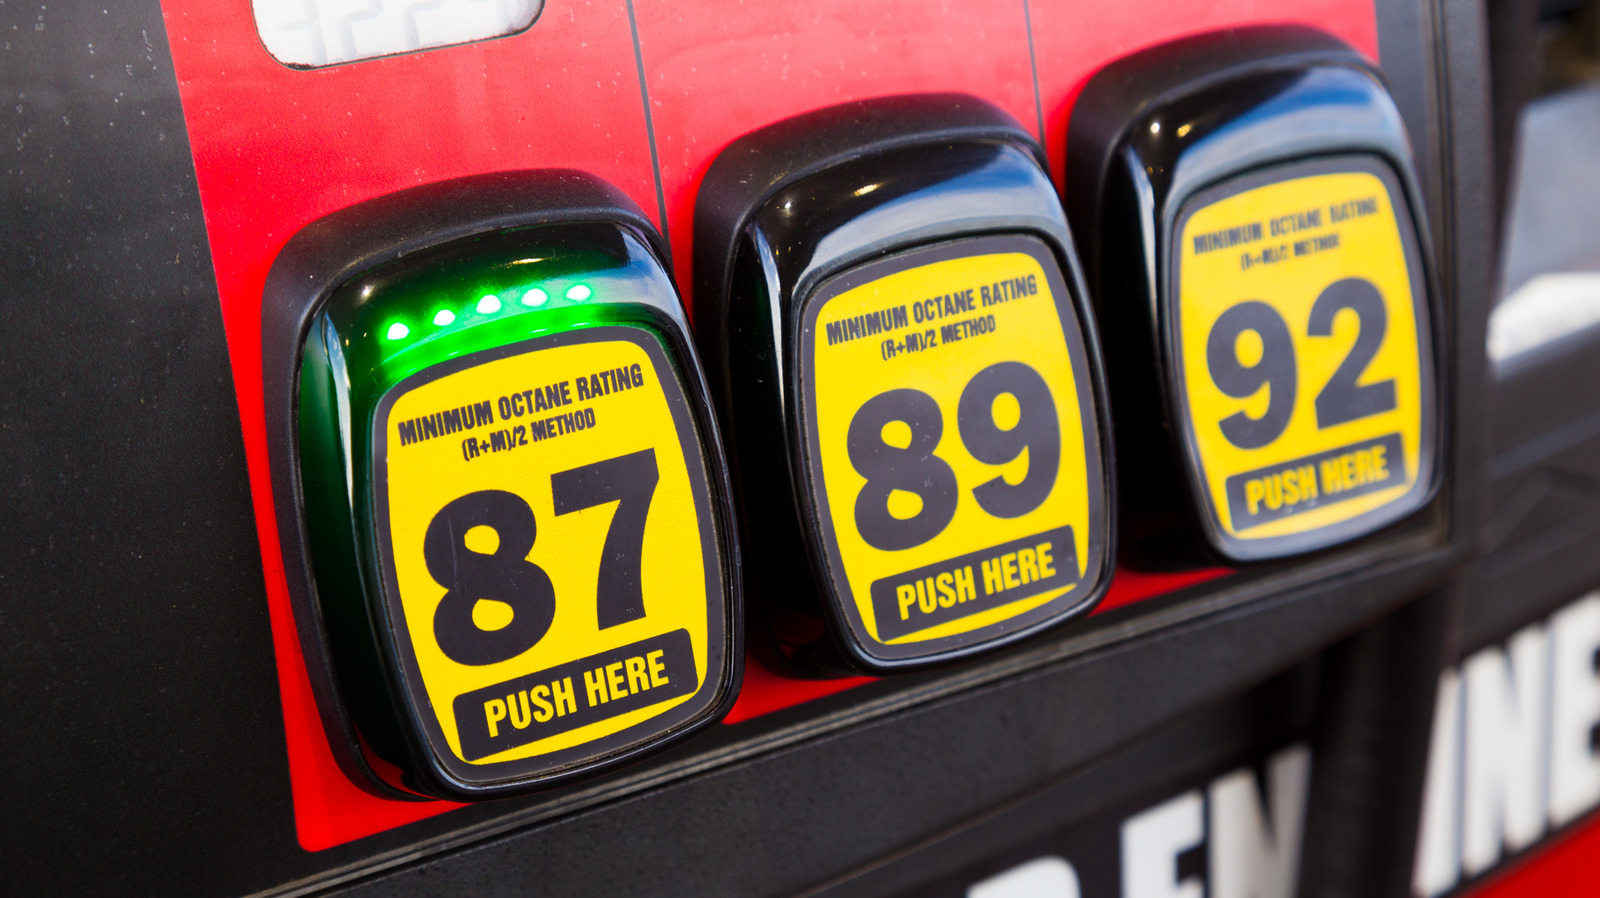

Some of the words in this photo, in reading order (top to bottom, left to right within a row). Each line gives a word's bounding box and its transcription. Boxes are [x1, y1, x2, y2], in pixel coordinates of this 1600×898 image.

[826, 304, 909, 346] MINIMUM
[912, 288, 976, 322] OCTANE
[980, 274, 1039, 308] RATING
[880, 326, 938, 361] (R+M)/2
[941, 313, 997, 346] METHOD
[398, 399, 493, 447] MINIMUM
[498, 380, 571, 421] OCTANE
[576, 363, 645, 401] RATING
[1206, 277, 1399, 452] 92
[461, 422, 529, 462] (R+M)/2
[532, 407, 597, 442] METHOD
[847, 360, 1062, 552] 89
[1244, 464, 1319, 516] PUSH
[1319, 445, 1391, 496] HERE
[423, 447, 660, 667] 87
[896, 566, 977, 621] PUSH
[981, 542, 1057, 590] HERE
[483, 684, 578, 738] PUSH
[583, 649, 670, 705] HERE
